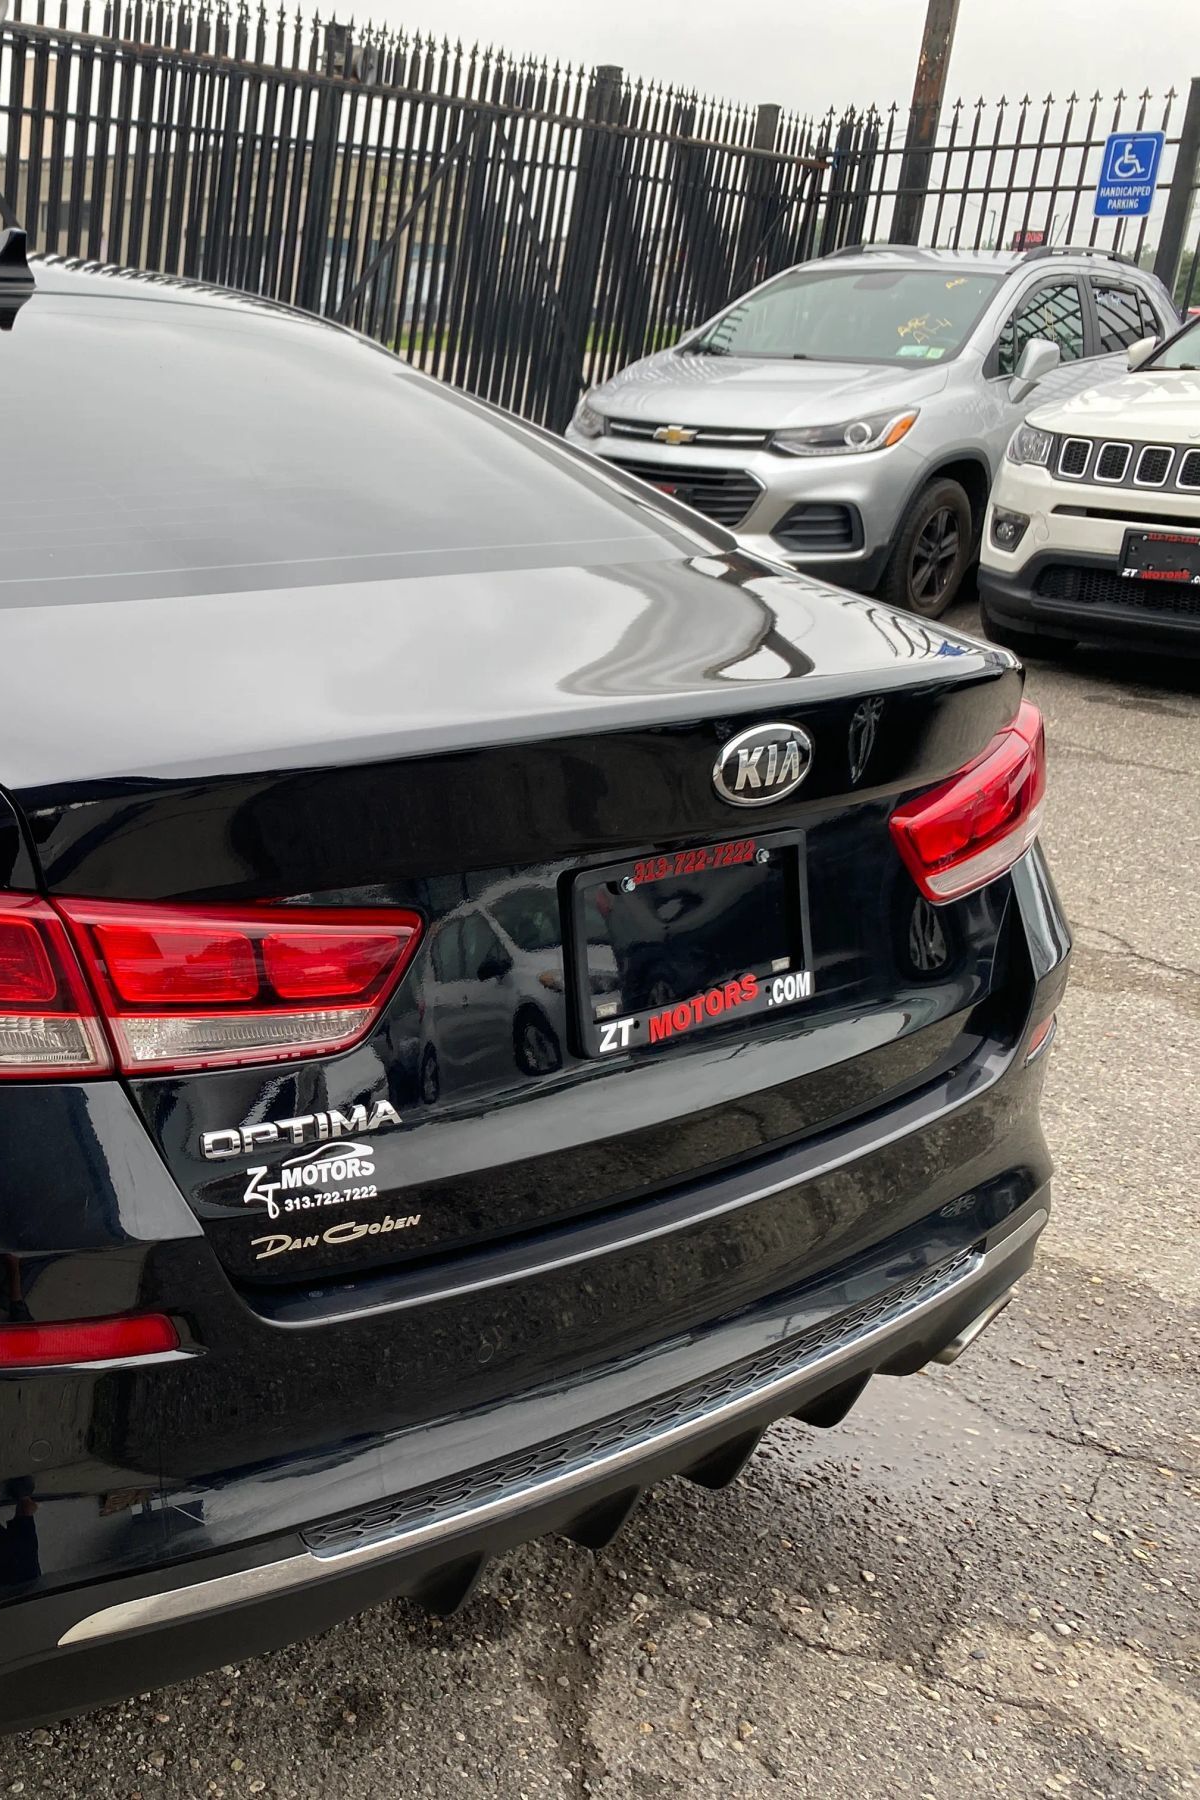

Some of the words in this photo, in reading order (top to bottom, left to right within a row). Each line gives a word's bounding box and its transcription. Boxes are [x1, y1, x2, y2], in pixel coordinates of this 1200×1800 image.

[1100, 186, 1151, 197] HANDICAPPED
[1107, 198, 1139, 209] PARKING
[1121, 567, 1138, 577] ZT
[1141, 570, 1190, 580] MOTORS
[734, 740, 801, 791] KIA
[633, 840, 757, 885] 313-722-7222
[599, 1017, 634, 1053] ZT
[648, 972, 760, 1044] MOTORS
[767, 971, 811, 1007] .COM
[200, 1099, 403, 1160] OPTIMA
[281, 1157, 376, 1190] MOTORS
[284, 1184, 378, 1213] 313.722.7222
